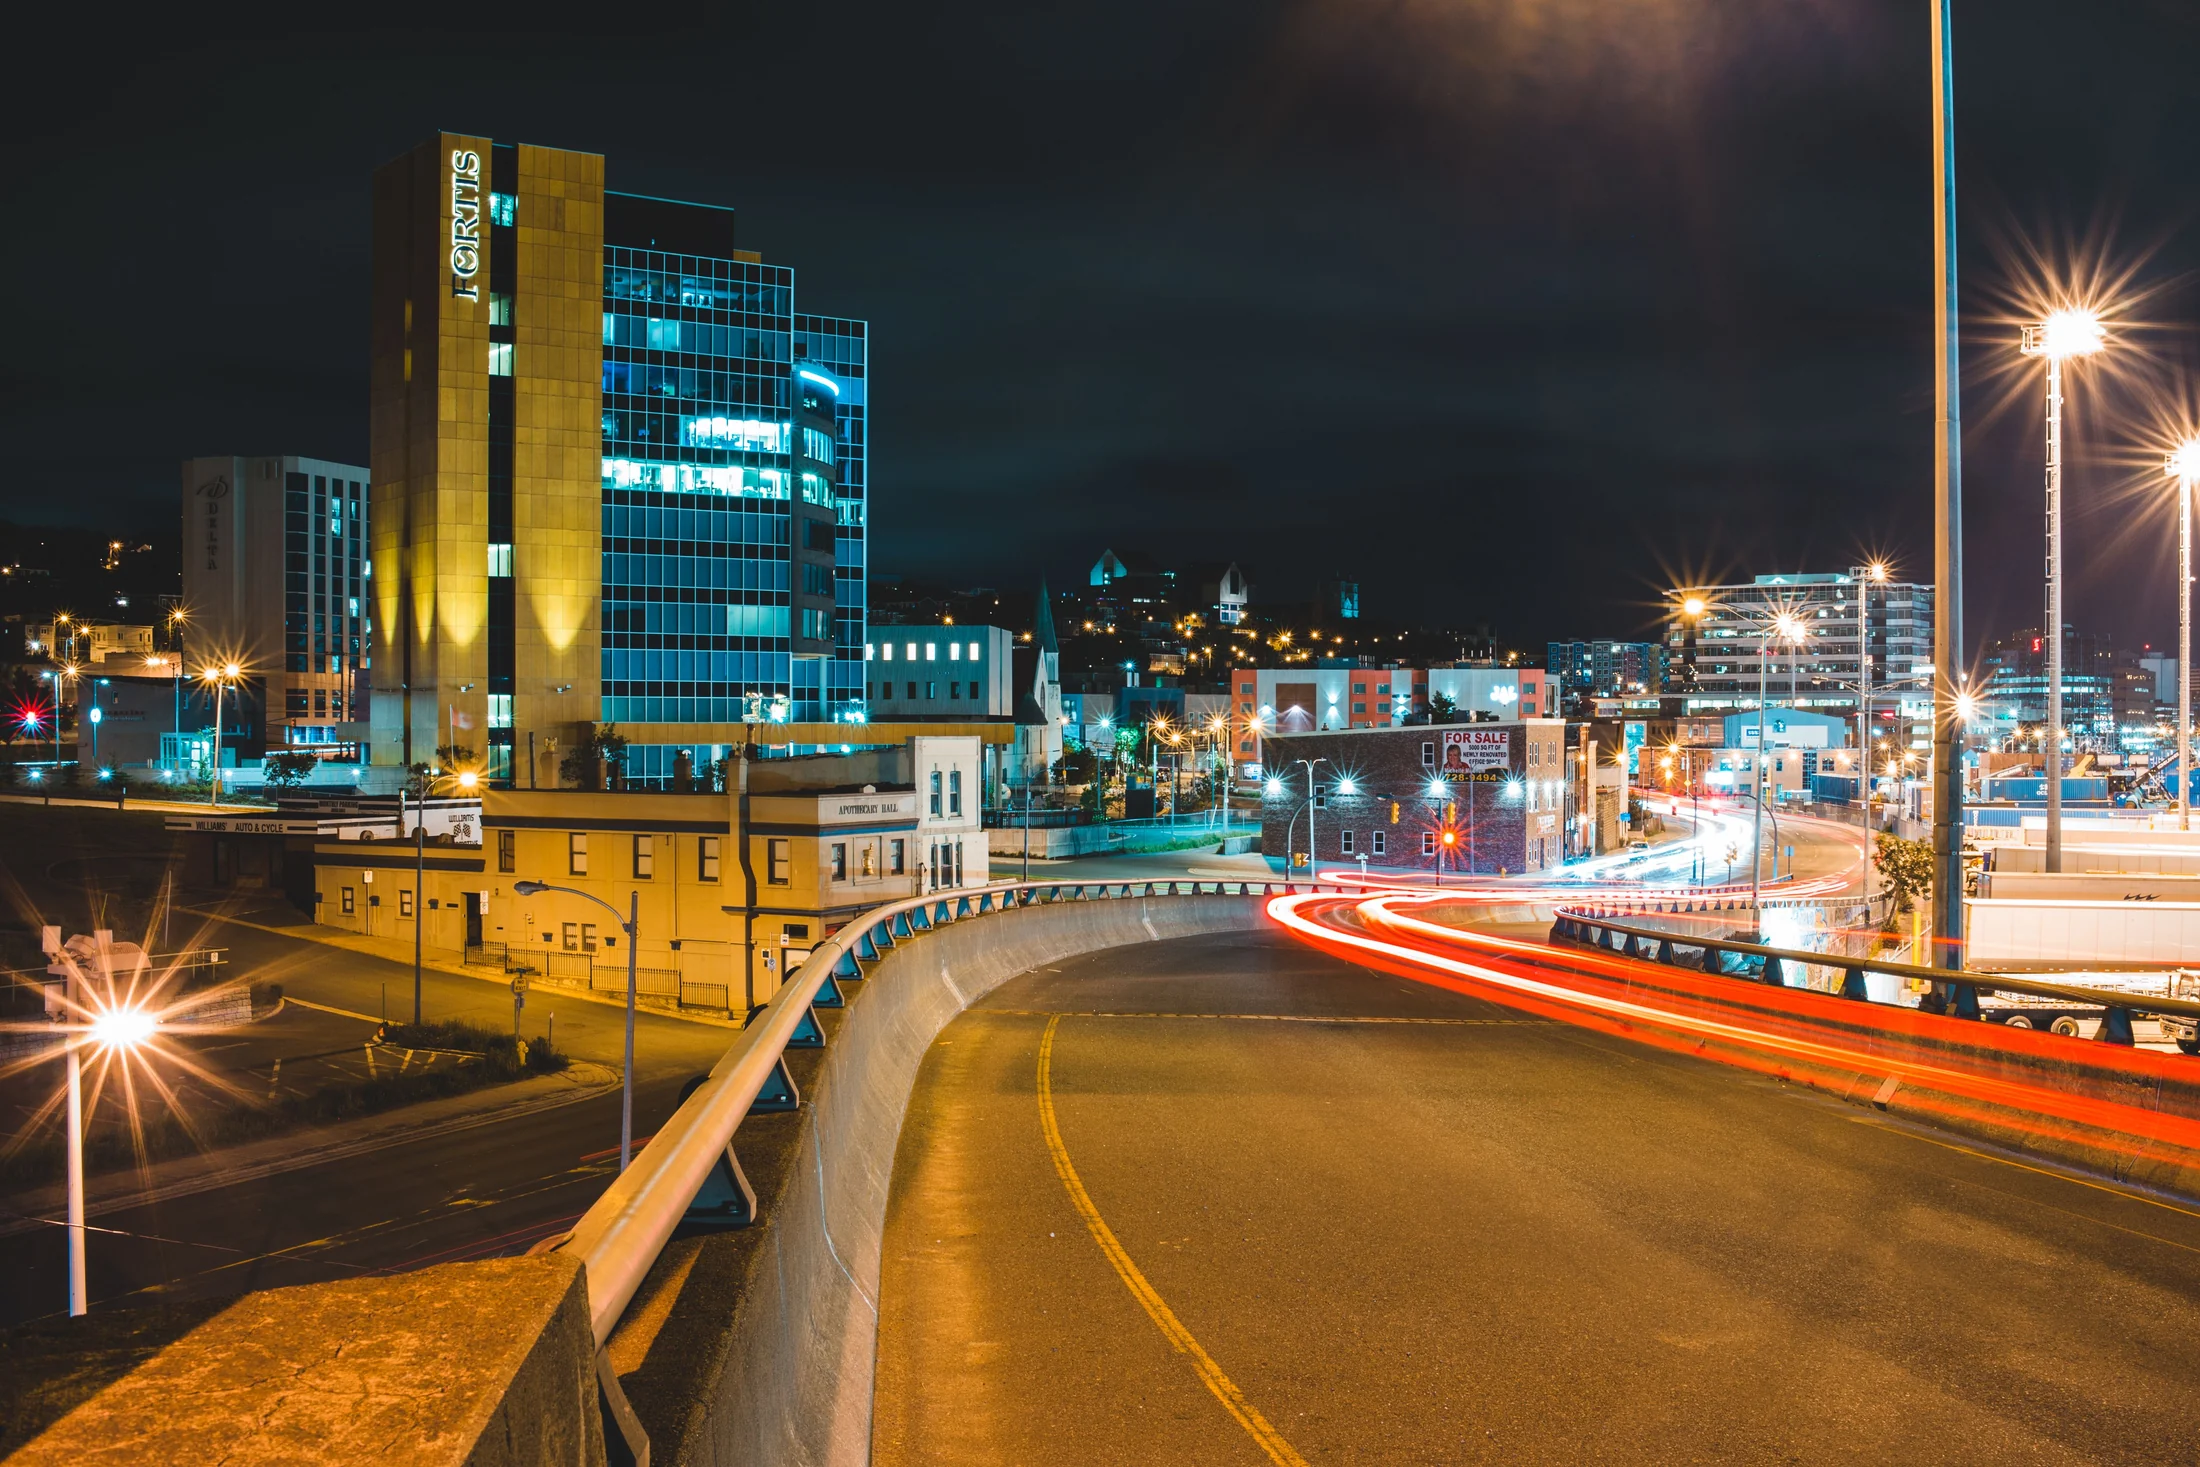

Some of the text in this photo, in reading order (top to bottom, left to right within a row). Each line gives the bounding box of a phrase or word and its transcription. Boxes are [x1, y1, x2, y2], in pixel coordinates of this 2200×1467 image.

[451, 150, 480, 303] FORTIS
[205, 502, 218, 570] DELTA
[1445, 733, 1507, 743] FOR SALE
[1445, 773, 1496, 781] 728-9494
[838, 803, 898, 815] APOTHECARY HALL
[235, 823, 253, 831] AUTO
[261, 824, 283, 832] CYCLE
